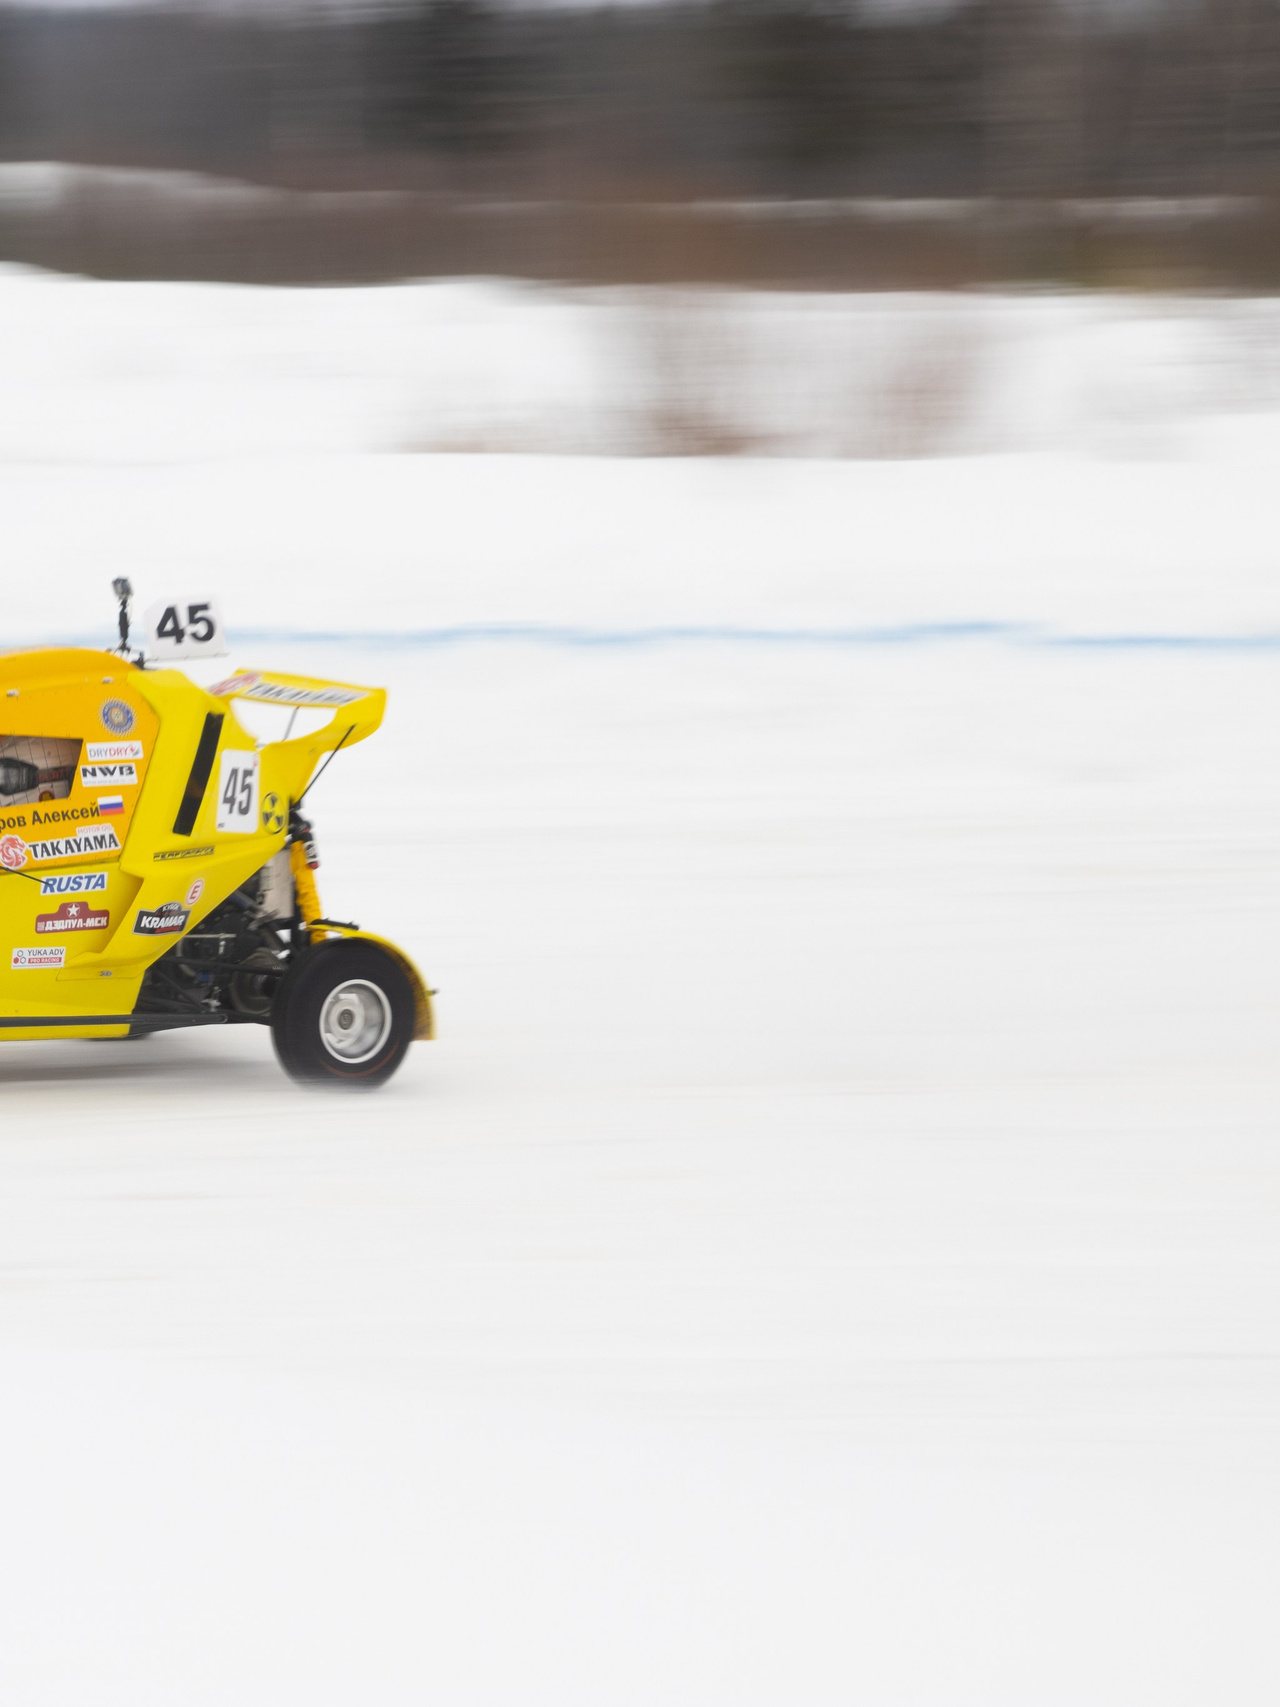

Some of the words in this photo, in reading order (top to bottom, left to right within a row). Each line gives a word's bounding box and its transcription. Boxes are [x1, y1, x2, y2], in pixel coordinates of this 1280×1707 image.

[156, 603, 214, 644] 45
[89, 747, 129, 758] DRYDRY
[82, 766, 134, 777] NWB
[223, 768, 253, 815] 45
[32, 802, 100, 825] Алексей
[29, 833, 118, 858] TAKAYAMA
[42, 874, 105, 893] RUSTA
[190, 885, 200, 899] E
[45, 917, 107, 931] ДЭДПУЛ-МСК
[141, 915, 185, 928] KRAMAR
[49, 948, 64, 956] ADV
